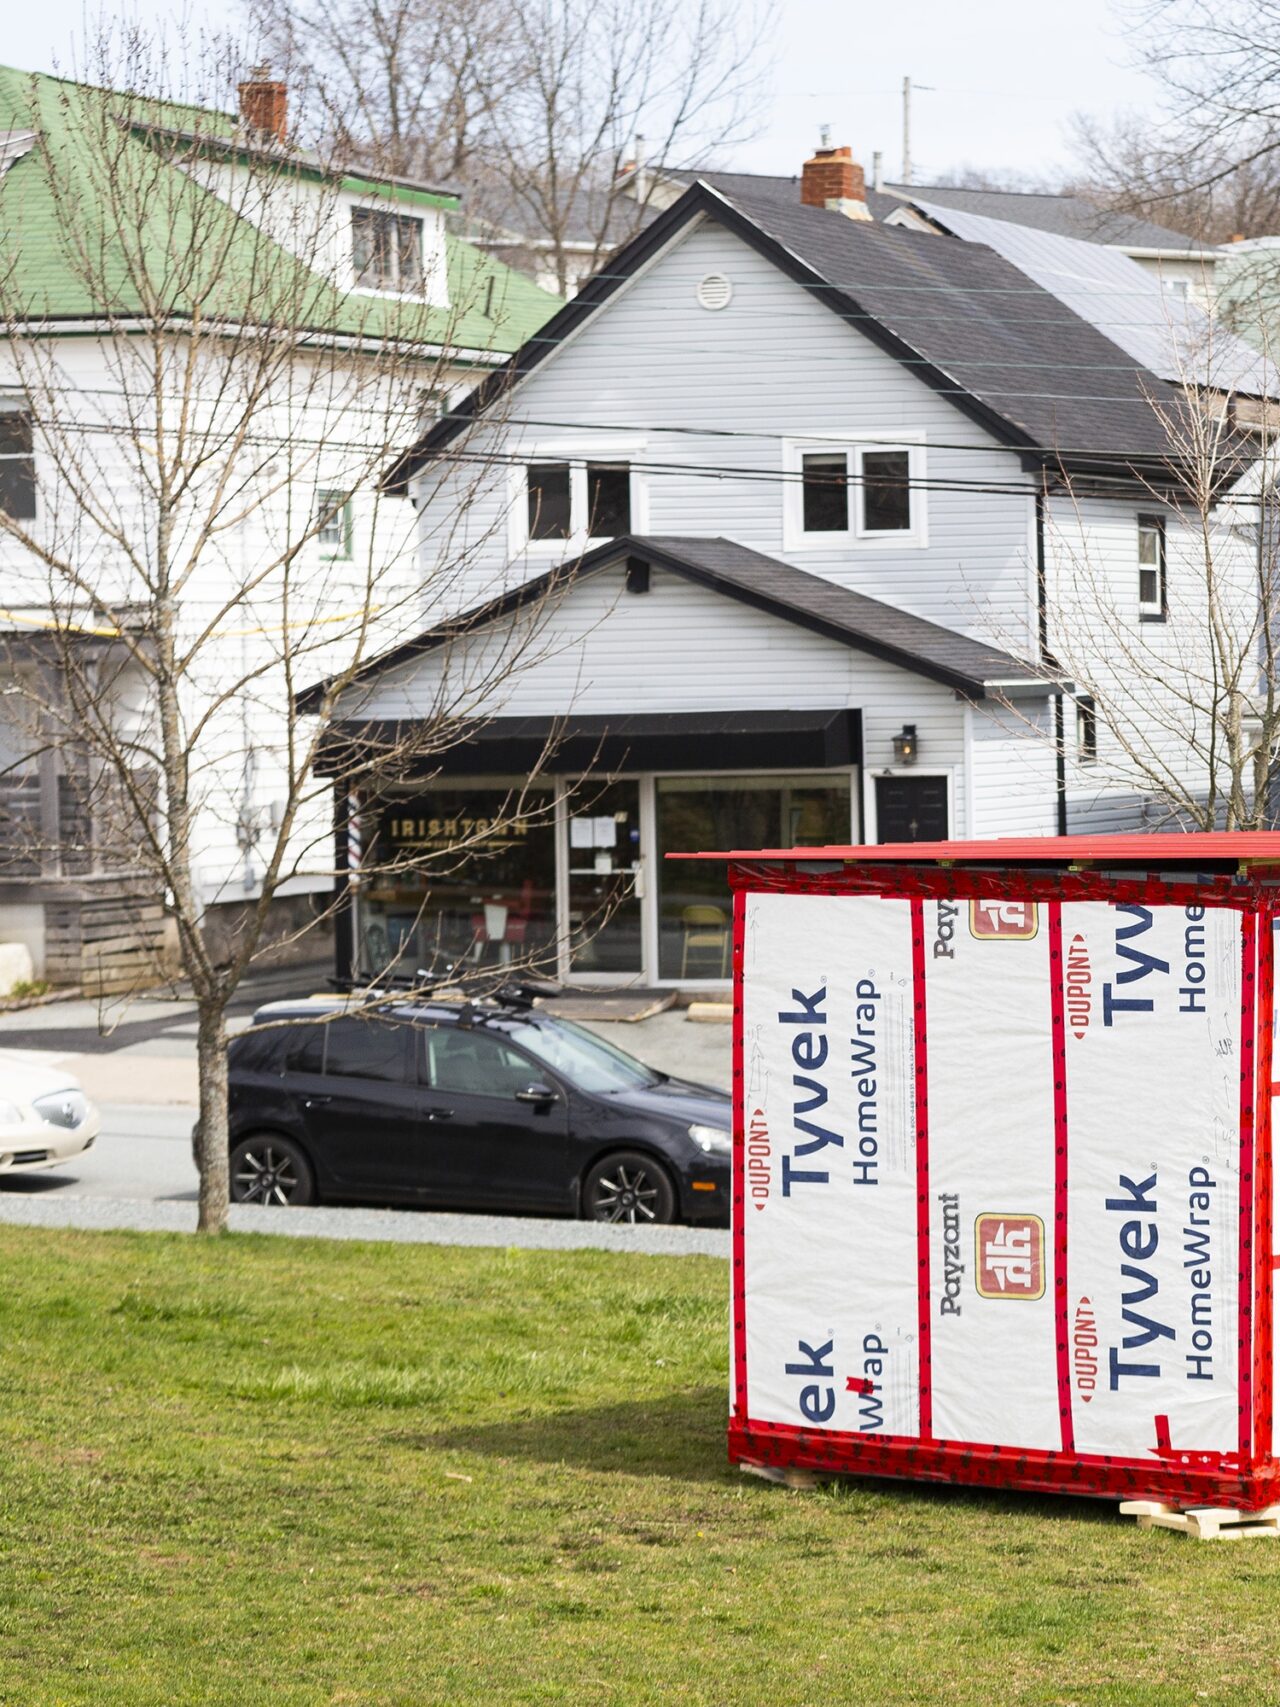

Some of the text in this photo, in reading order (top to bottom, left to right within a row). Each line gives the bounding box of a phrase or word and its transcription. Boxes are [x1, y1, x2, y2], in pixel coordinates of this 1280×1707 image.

[1066, 945, 1092, 1027] DUPONT
[749, 1119, 772, 1197] DUPONT
[938, 1193, 965, 1317] Payzant
[785, 1338, 836, 1423] ek
[1074, 1307, 1098, 1390] DUPONT
